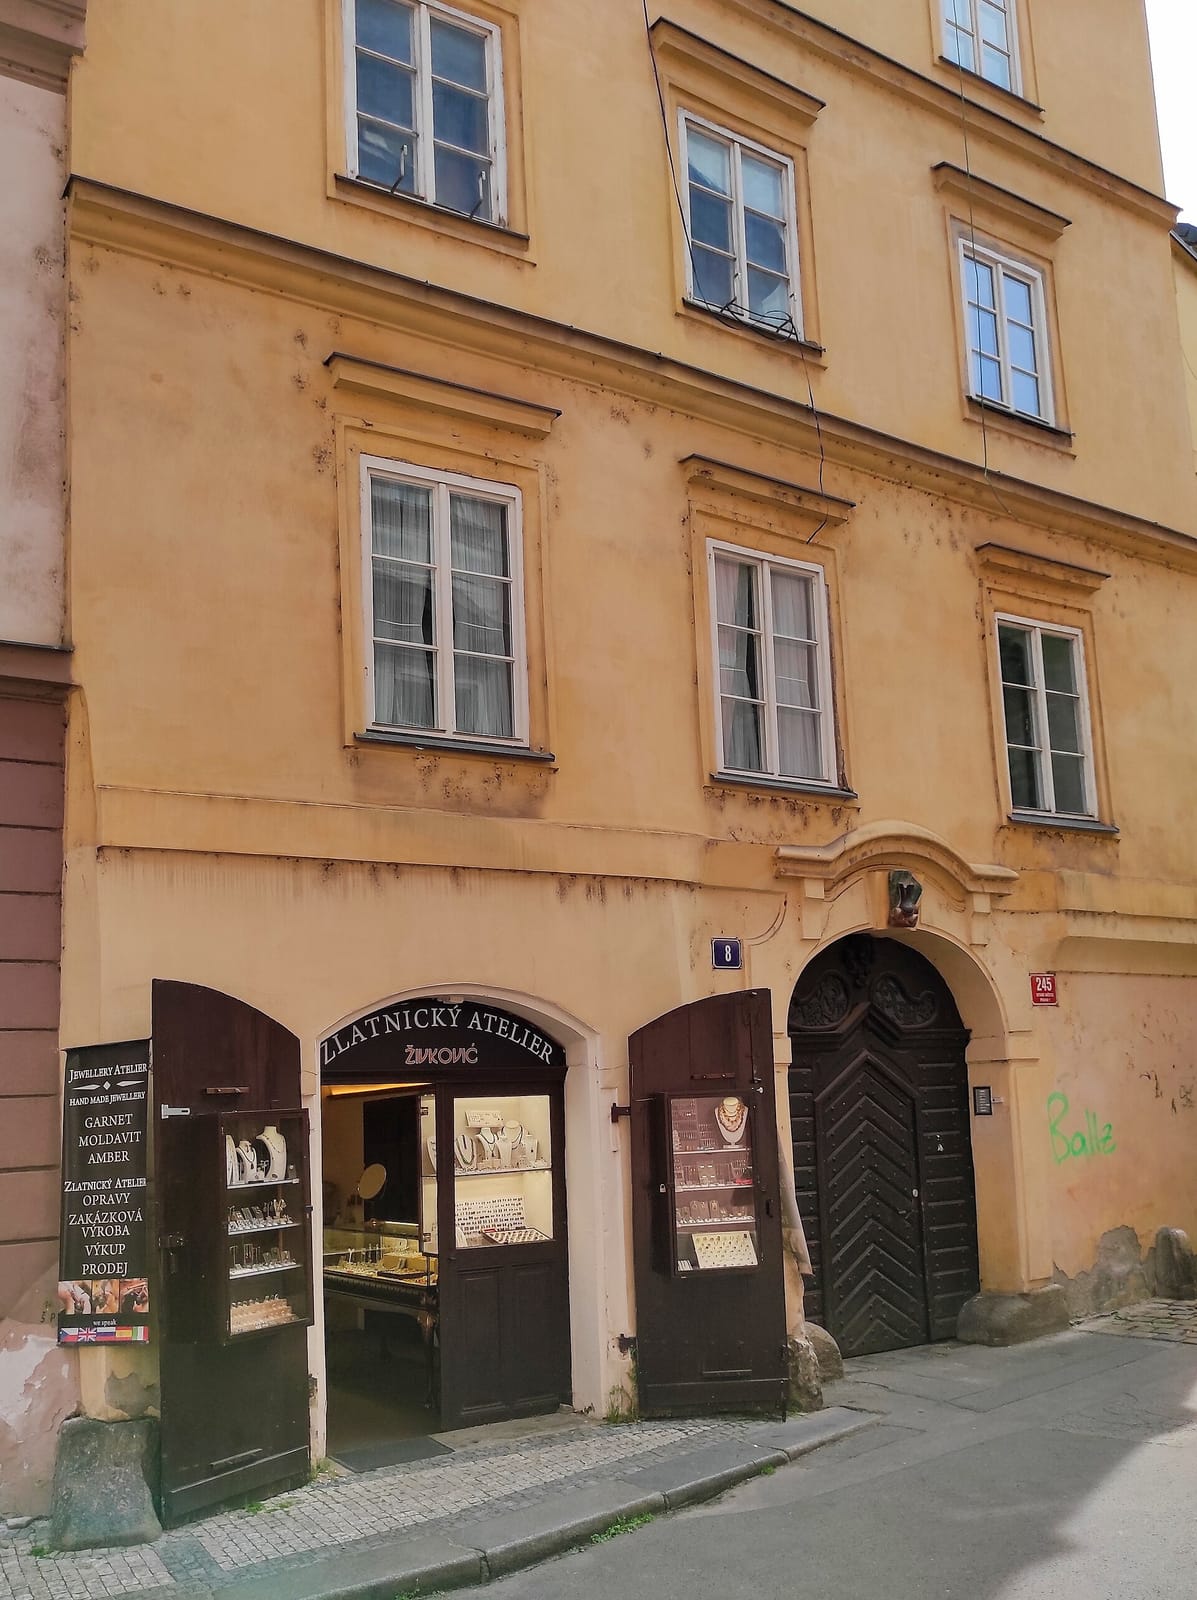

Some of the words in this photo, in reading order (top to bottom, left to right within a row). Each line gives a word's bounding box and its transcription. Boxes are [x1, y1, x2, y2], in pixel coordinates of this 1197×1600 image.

[724, 944, 732, 962] 8
[1035, 977, 1053, 992] 245
[320, 1005, 462, 1065] ZLATNICKÝ
[467, 1011, 553, 1065] ATELIER
[68, 1066, 113, 1083] JEWELLERY
[113, 1063, 148, 1076] ATELIER
[69, 1097, 90, 1106] HAND
[90, 1094, 109, 1104] MADE
[109, 1091, 146, 1104] JEWELLERY
[84, 1113, 133, 1129] GARNET
[78, 1131, 141, 1147] MOLDAVIT
[87, 1150, 130, 1164] AMBER
[64, 1178, 112, 1192] ZLATNICKÝ
[82, 1192, 131, 1207] OPRAVY
[68, 1208, 143, 1226] ZAKÁZKOVÁ
[81, 1224, 130, 1238] VÝROBA
[85, 1242, 126, 1256] VÝKUP
[81, 1262, 128, 1277] PRODEJ
